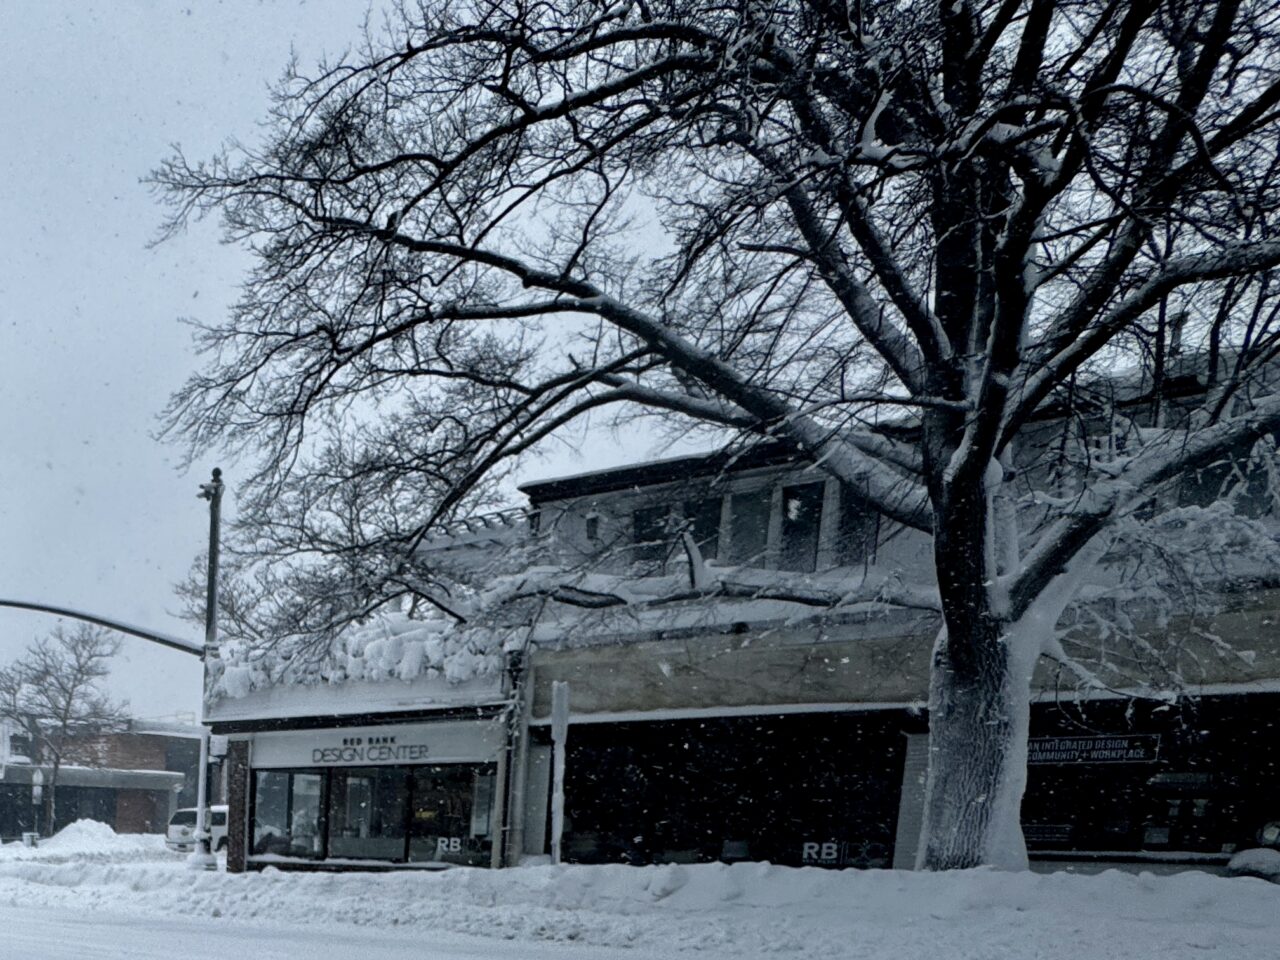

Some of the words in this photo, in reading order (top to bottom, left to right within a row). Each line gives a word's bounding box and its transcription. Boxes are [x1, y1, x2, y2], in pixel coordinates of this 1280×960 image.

[343, 737, 362, 746] RED
[368, 736, 396, 745] BANK
[1041, 739, 1092, 751] INTEGRATED
[1095, 739, 1128, 750] DESIGN
[312, 747, 364, 763] DESIGN
[366, 744, 429, 761] CENTER
[1090, 749, 1144, 760] WORKPLACE
[437, 837, 461, 852] RB
[802, 842, 838, 859] RB
